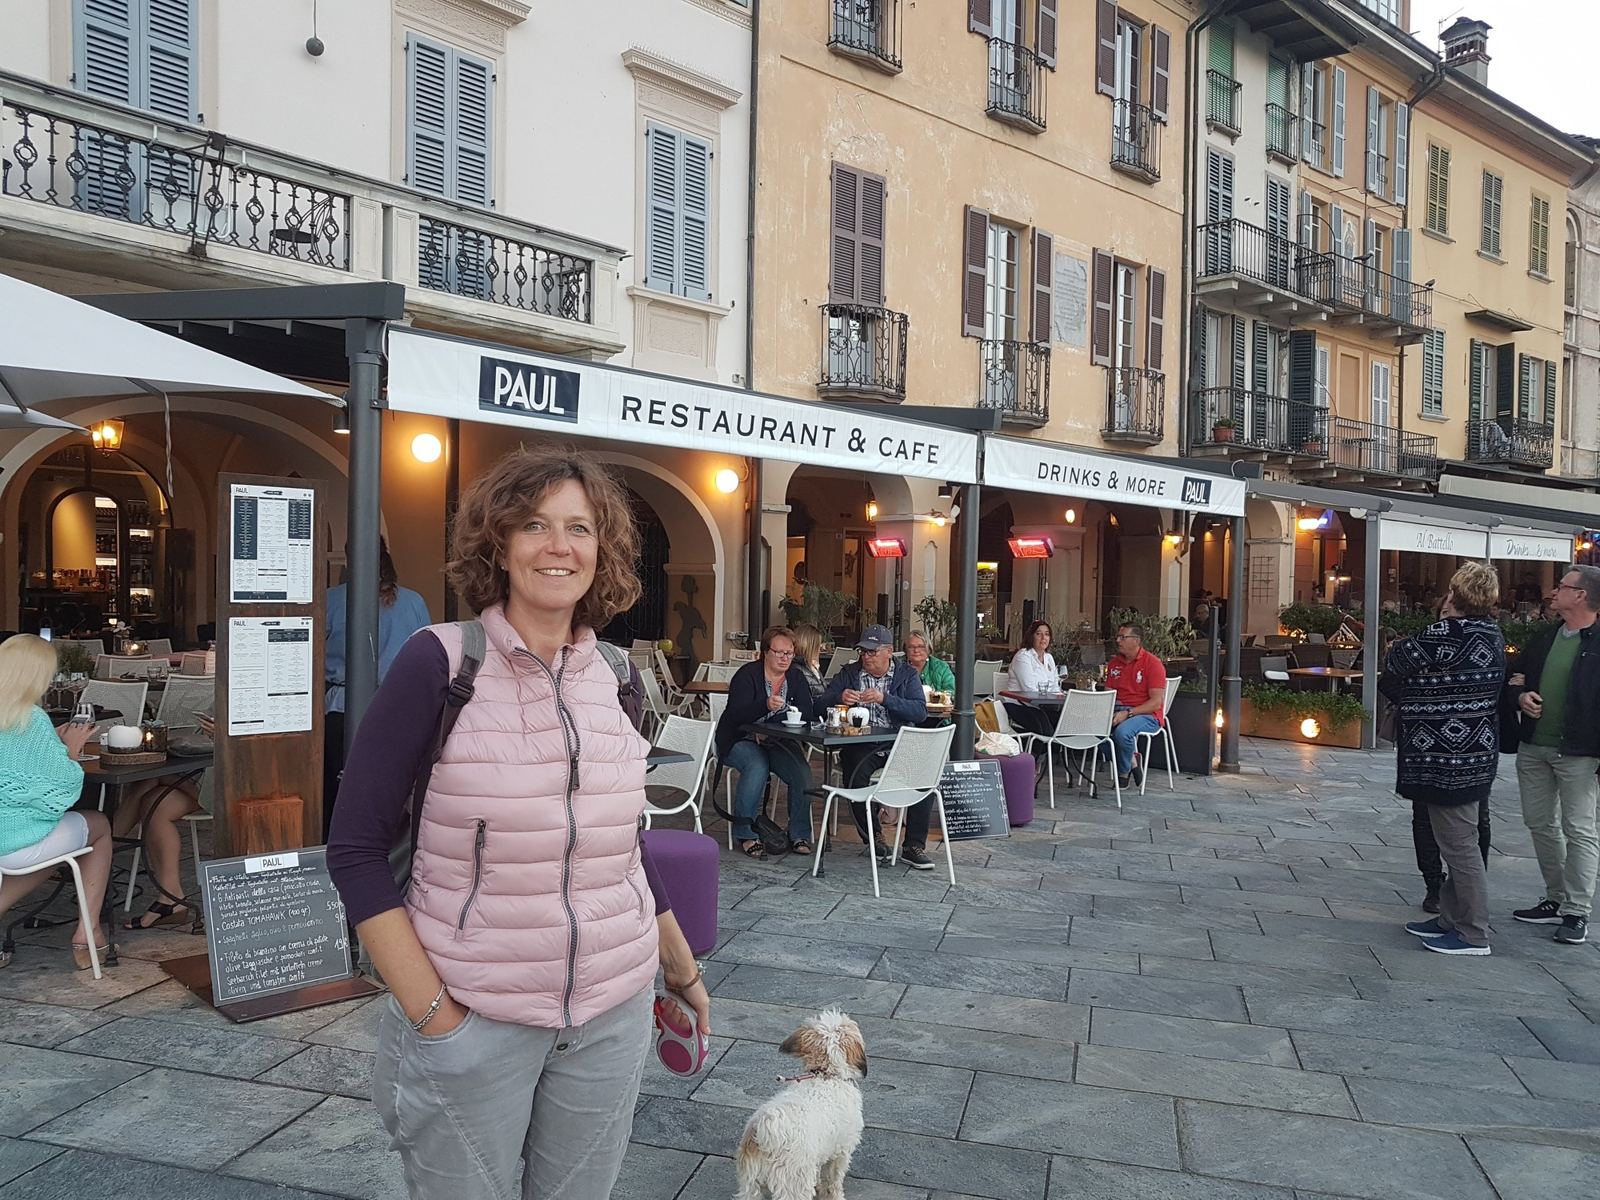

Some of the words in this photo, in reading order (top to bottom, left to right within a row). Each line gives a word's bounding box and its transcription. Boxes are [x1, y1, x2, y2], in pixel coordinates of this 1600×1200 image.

[494, 366, 565, 415] PAUL
[621, 395, 836, 449] RESTAURANT
[848, 427, 866, 453] &
[878, 436, 940, 464] CAFE
[235, 486, 248, 494] PAUL
[1037, 462, 1101, 487] DRINKS
[1107, 470, 1118, 489] &
[1125, 476, 1166, 496] MORE
[1184, 480, 1207, 503] PAUL
[262, 857, 282, 868] PAUL
[247, 910, 286, 925] TOMAHAWK
